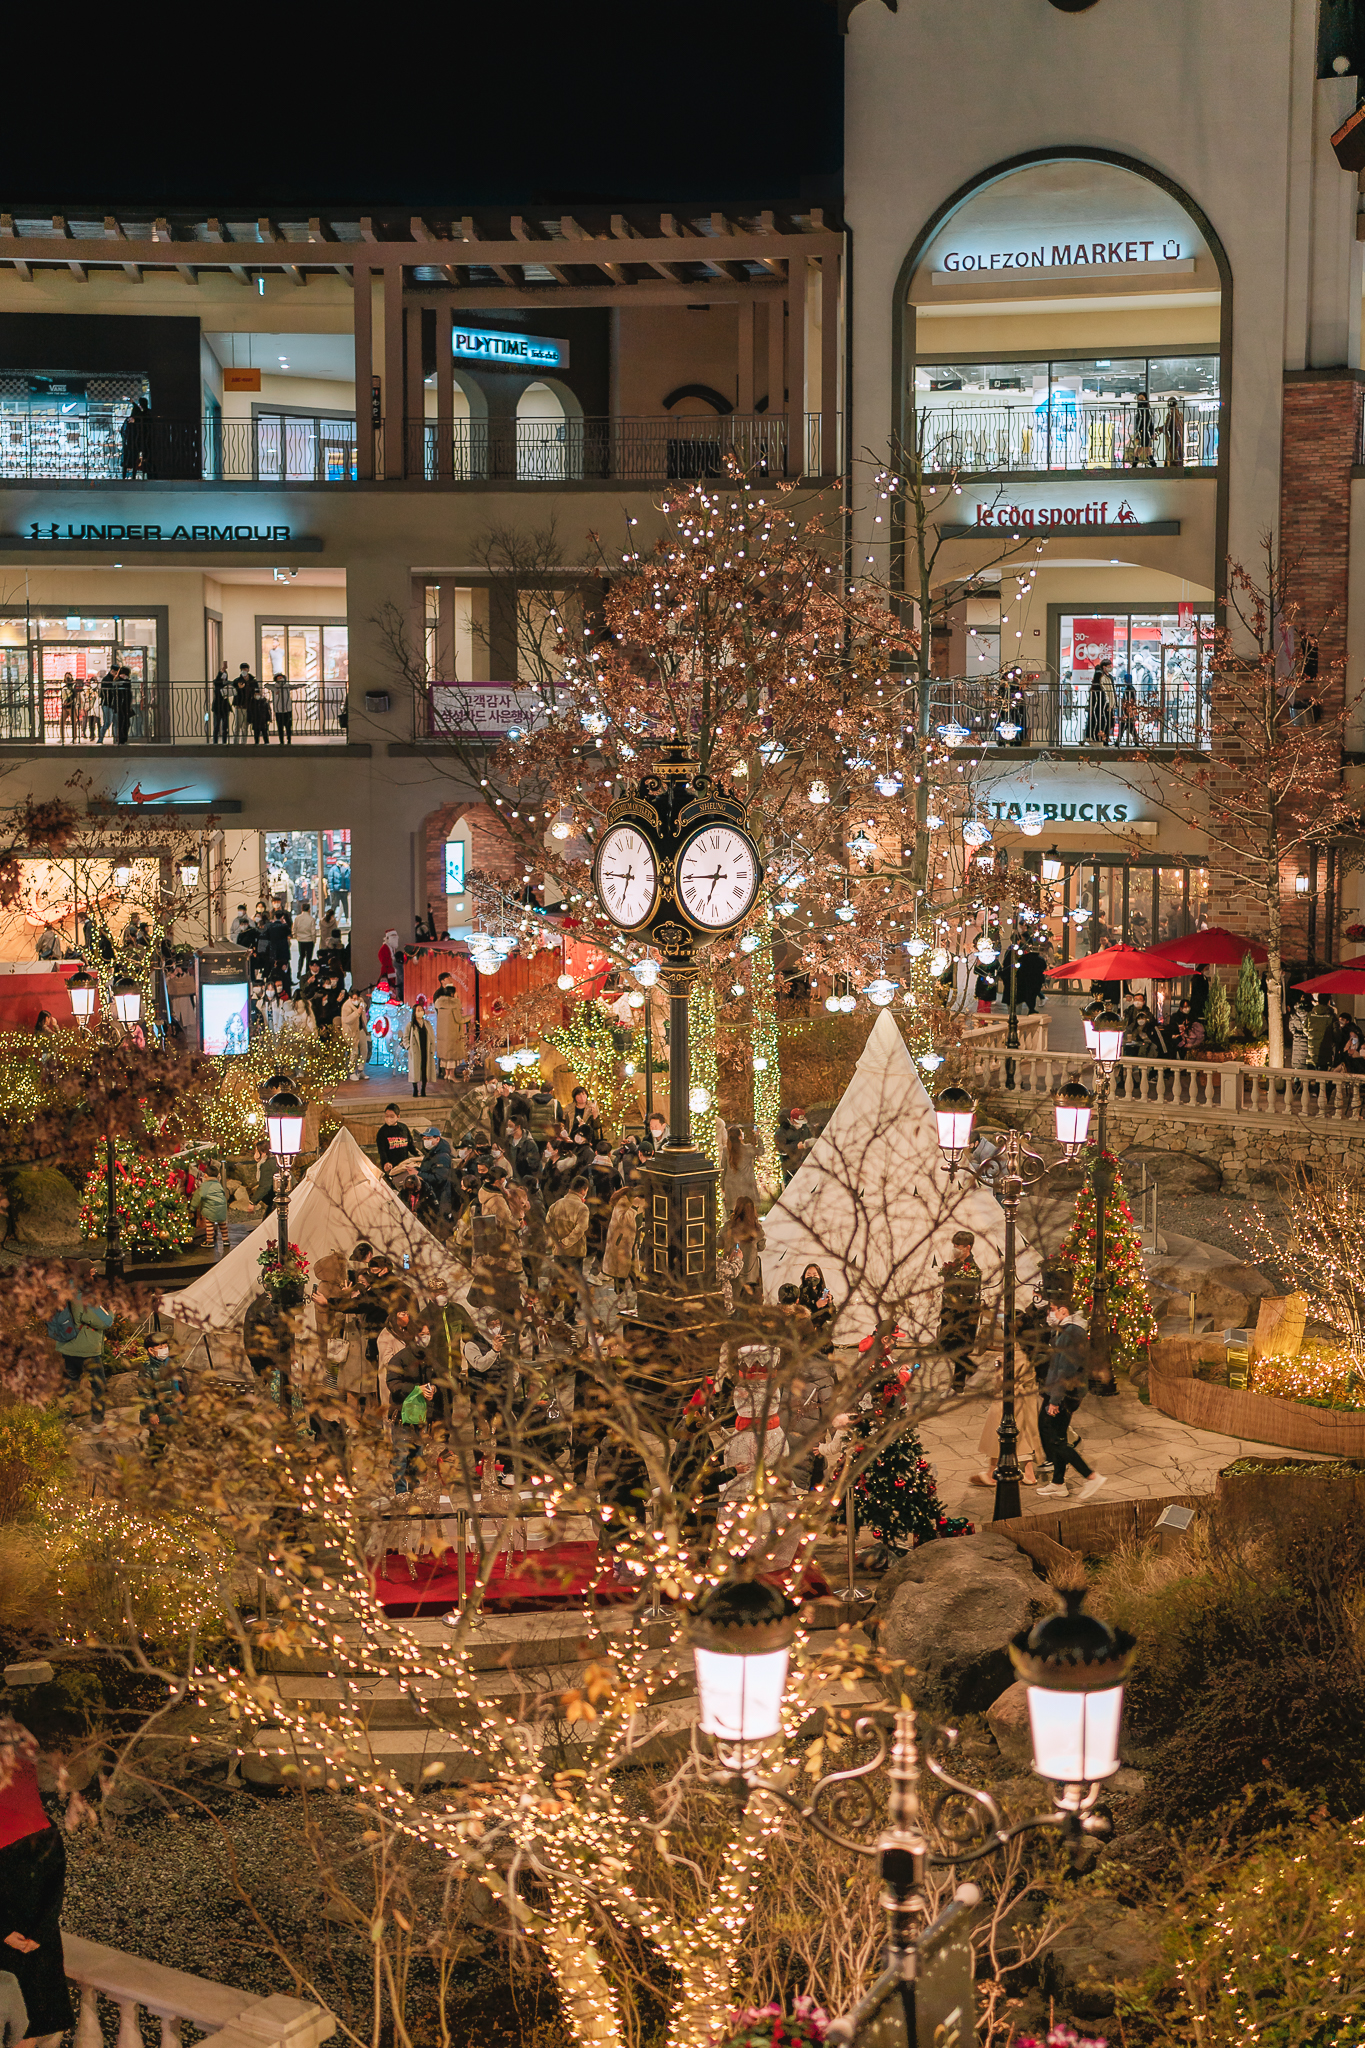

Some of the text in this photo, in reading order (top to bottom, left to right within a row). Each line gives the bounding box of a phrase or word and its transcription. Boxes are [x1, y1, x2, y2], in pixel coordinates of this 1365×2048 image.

[944, 240, 1155, 271] GOLFZON MARKET
[976, 501, 1108, 529] le coq sportif
[68, 524, 291, 540] UNDER ARMOUR
[462, 694, 511, 708] 고객감사
[489, 709, 535, 724] 사은행사
